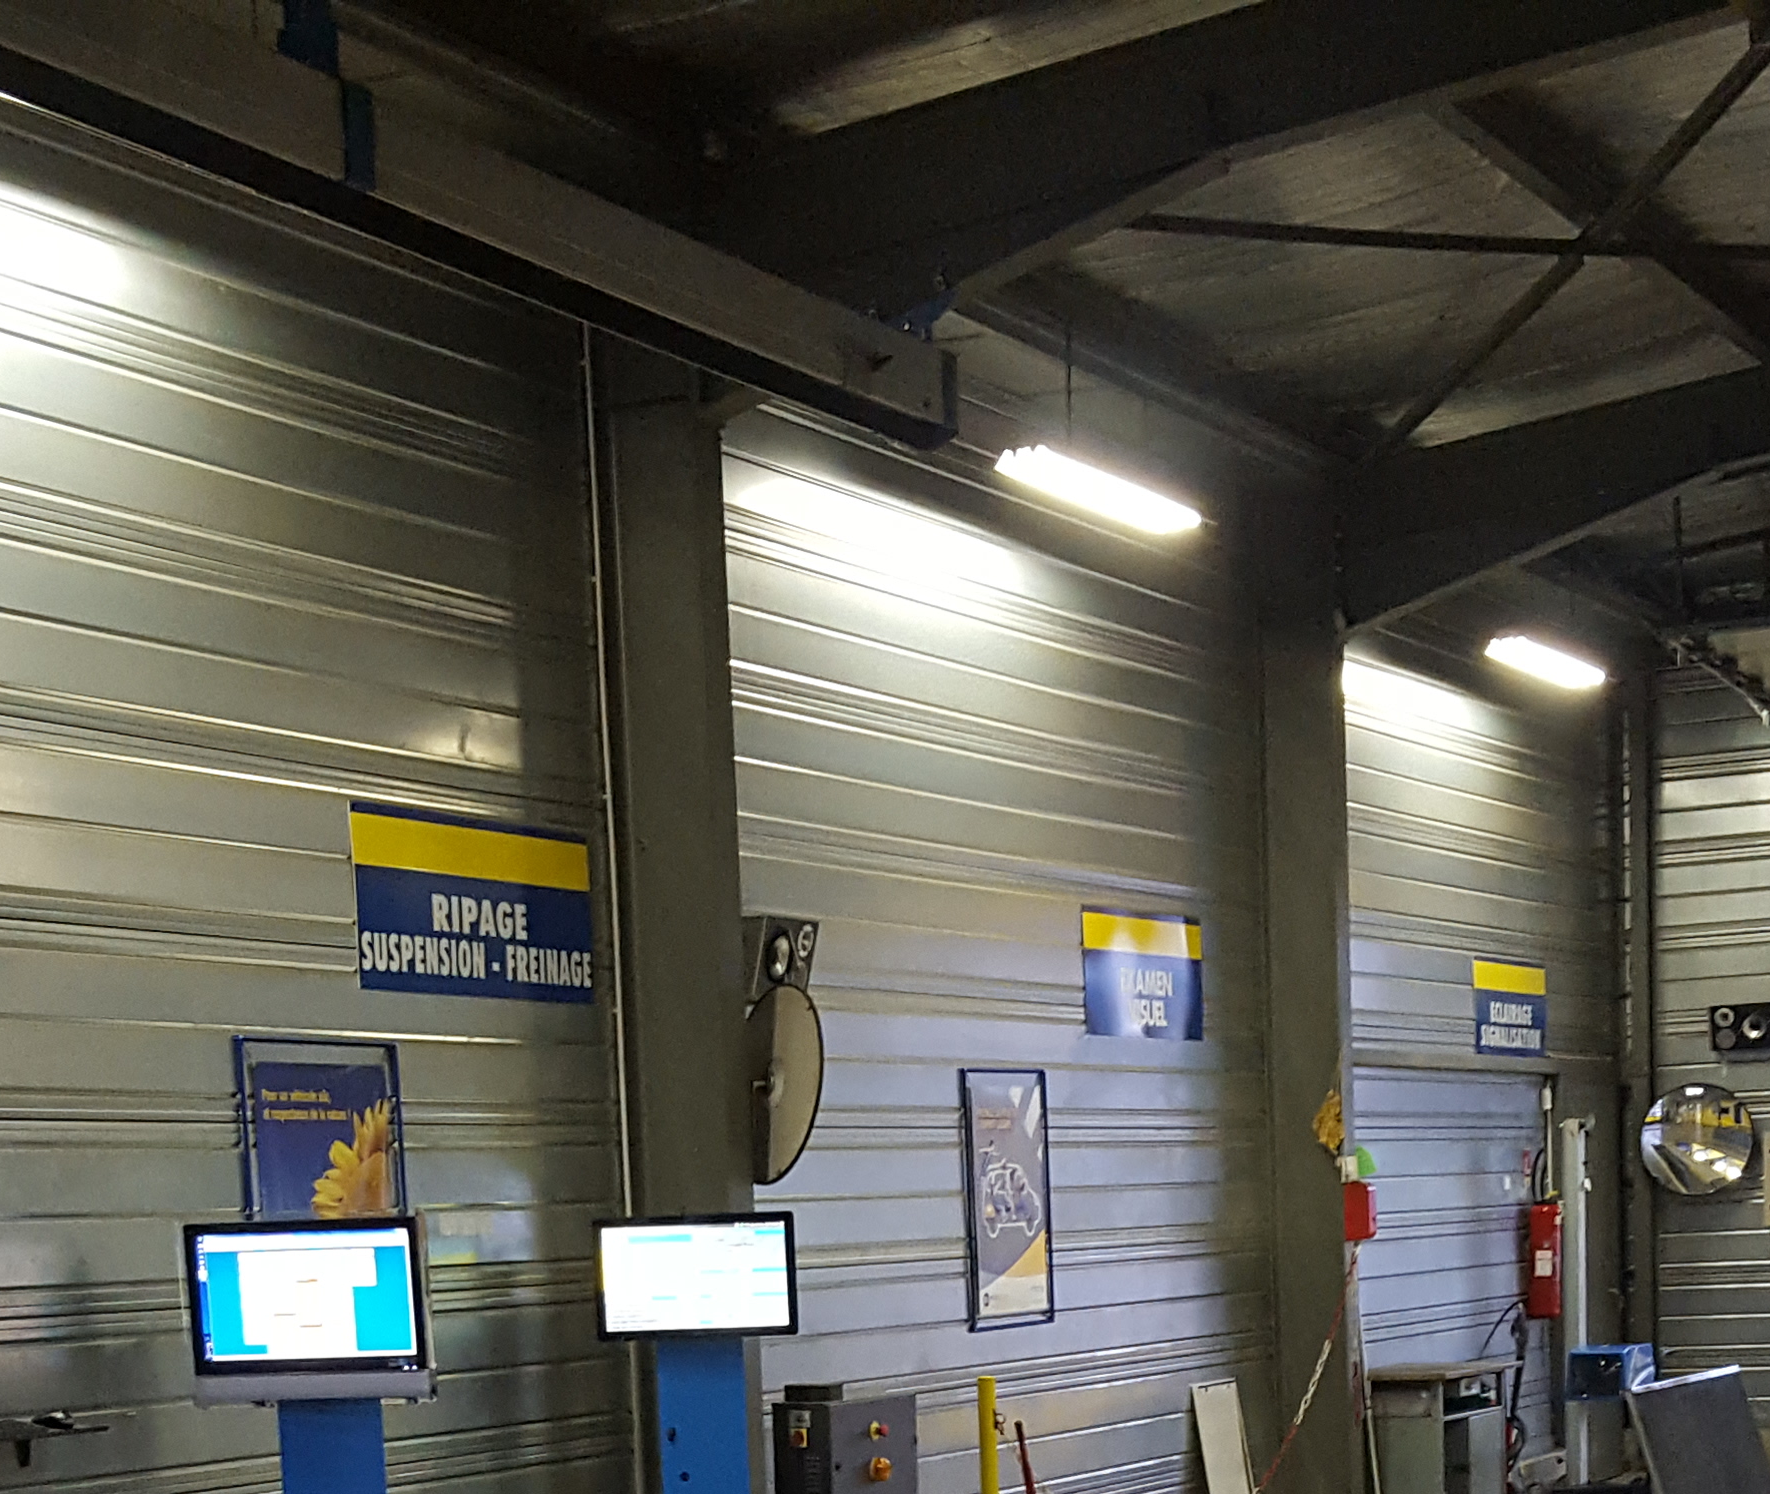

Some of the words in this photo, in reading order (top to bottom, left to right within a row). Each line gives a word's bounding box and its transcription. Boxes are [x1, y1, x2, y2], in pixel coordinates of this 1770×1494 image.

[431, 892, 529, 941] RIPAGE
[360, 930, 487, 980] SUSPENSION
[505, 944, 593, 989] FREINAGE
